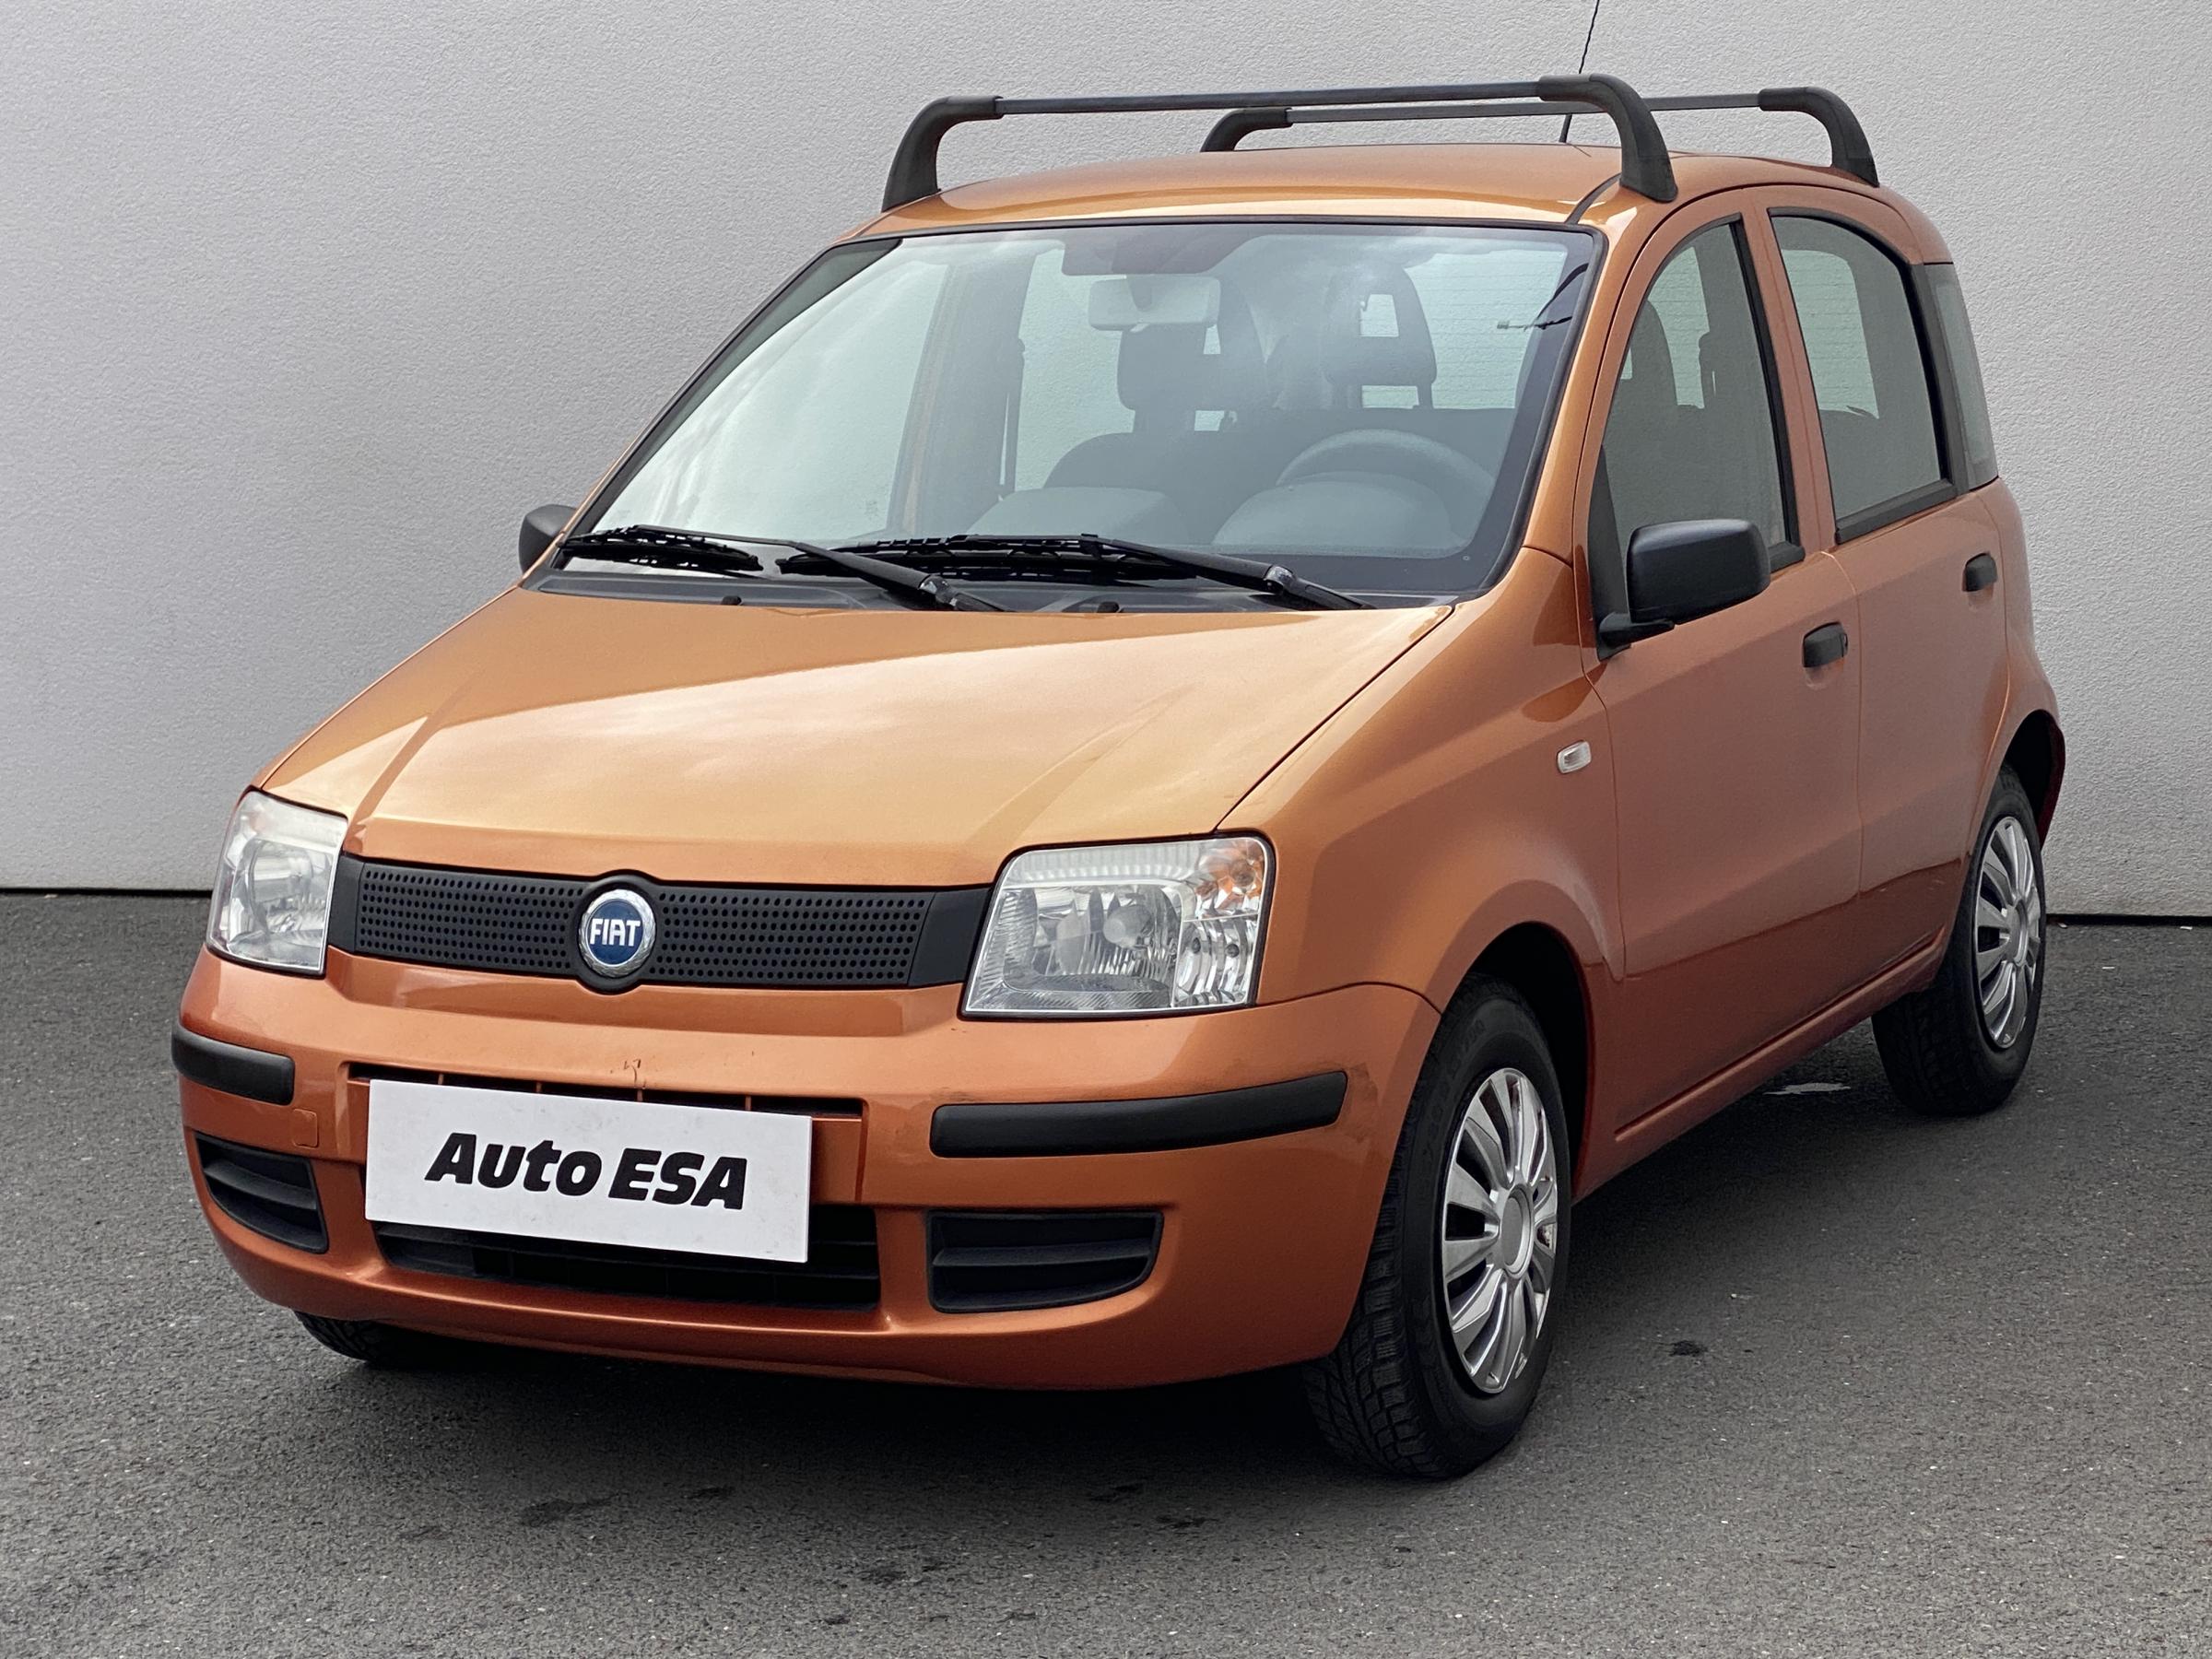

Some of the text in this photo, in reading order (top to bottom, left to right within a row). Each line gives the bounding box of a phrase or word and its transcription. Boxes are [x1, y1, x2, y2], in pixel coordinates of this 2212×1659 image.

[590, 918, 641, 947] FIAT
[424, 1133, 747, 1210] Auto ESA
